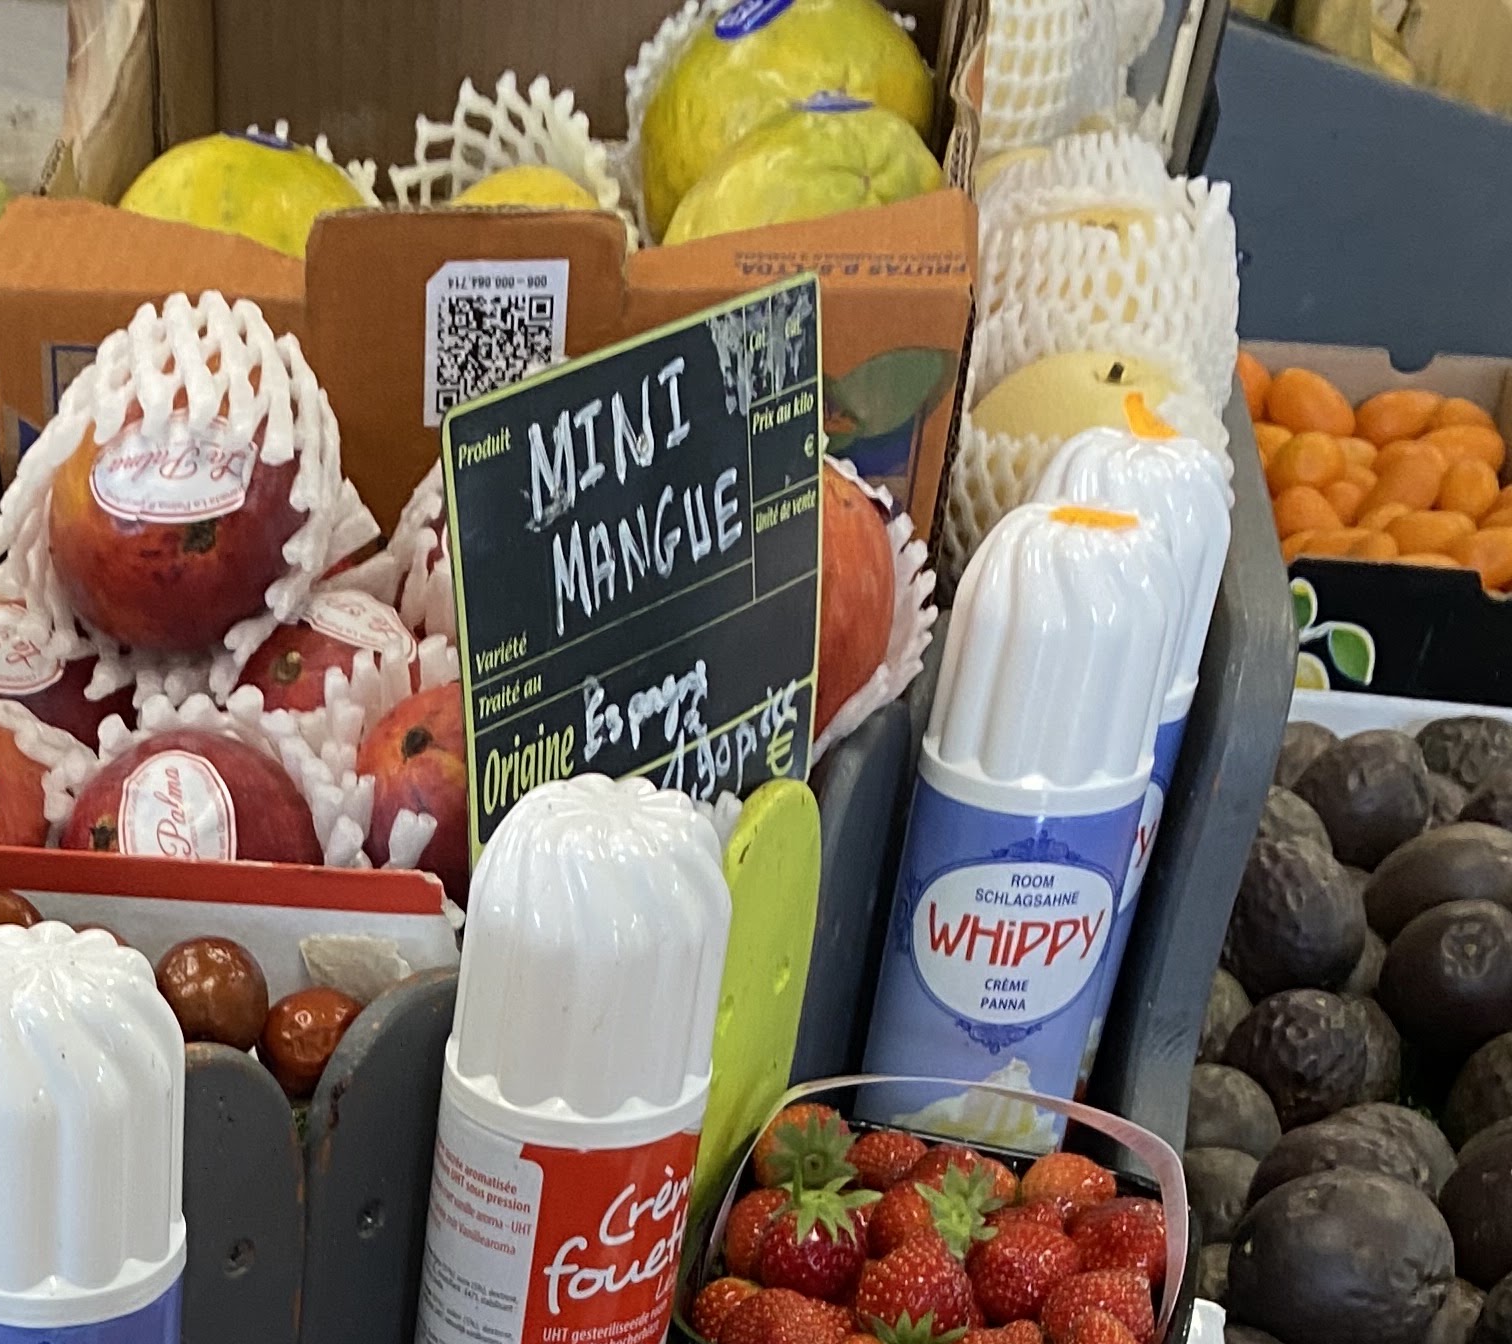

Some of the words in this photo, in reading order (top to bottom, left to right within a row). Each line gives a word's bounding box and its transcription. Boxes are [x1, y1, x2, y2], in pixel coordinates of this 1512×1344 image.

[752, 408, 775, 437] Prix
[776, 400, 792, 422] au
[793, 392, 815, 418] kilo
[458, 426, 513, 471] Produit
[528, 356, 692, 521] MINI
[755, 505, 780, 535] Unité
[780, 500, 792, 522] de
[792, 488, 818, 516] vente
[552, 467, 744, 638] MANGUE
[474, 633, 529, 676] Variété
[477, 682, 518, 720] Traité
[522, 675, 543, 700] au
[482, 722, 576, 817] Origine
[974, 887, 1080, 909] SCHLAGSAHNE
[1010, 874, 1055, 890] ROOM
[980, 996, 1027, 1012] PANNA
[984, 976, 1030, 993] CRÈME
[486, 1191, 531, 1214] pression
[543, 1328, 569, 1343] UHT
